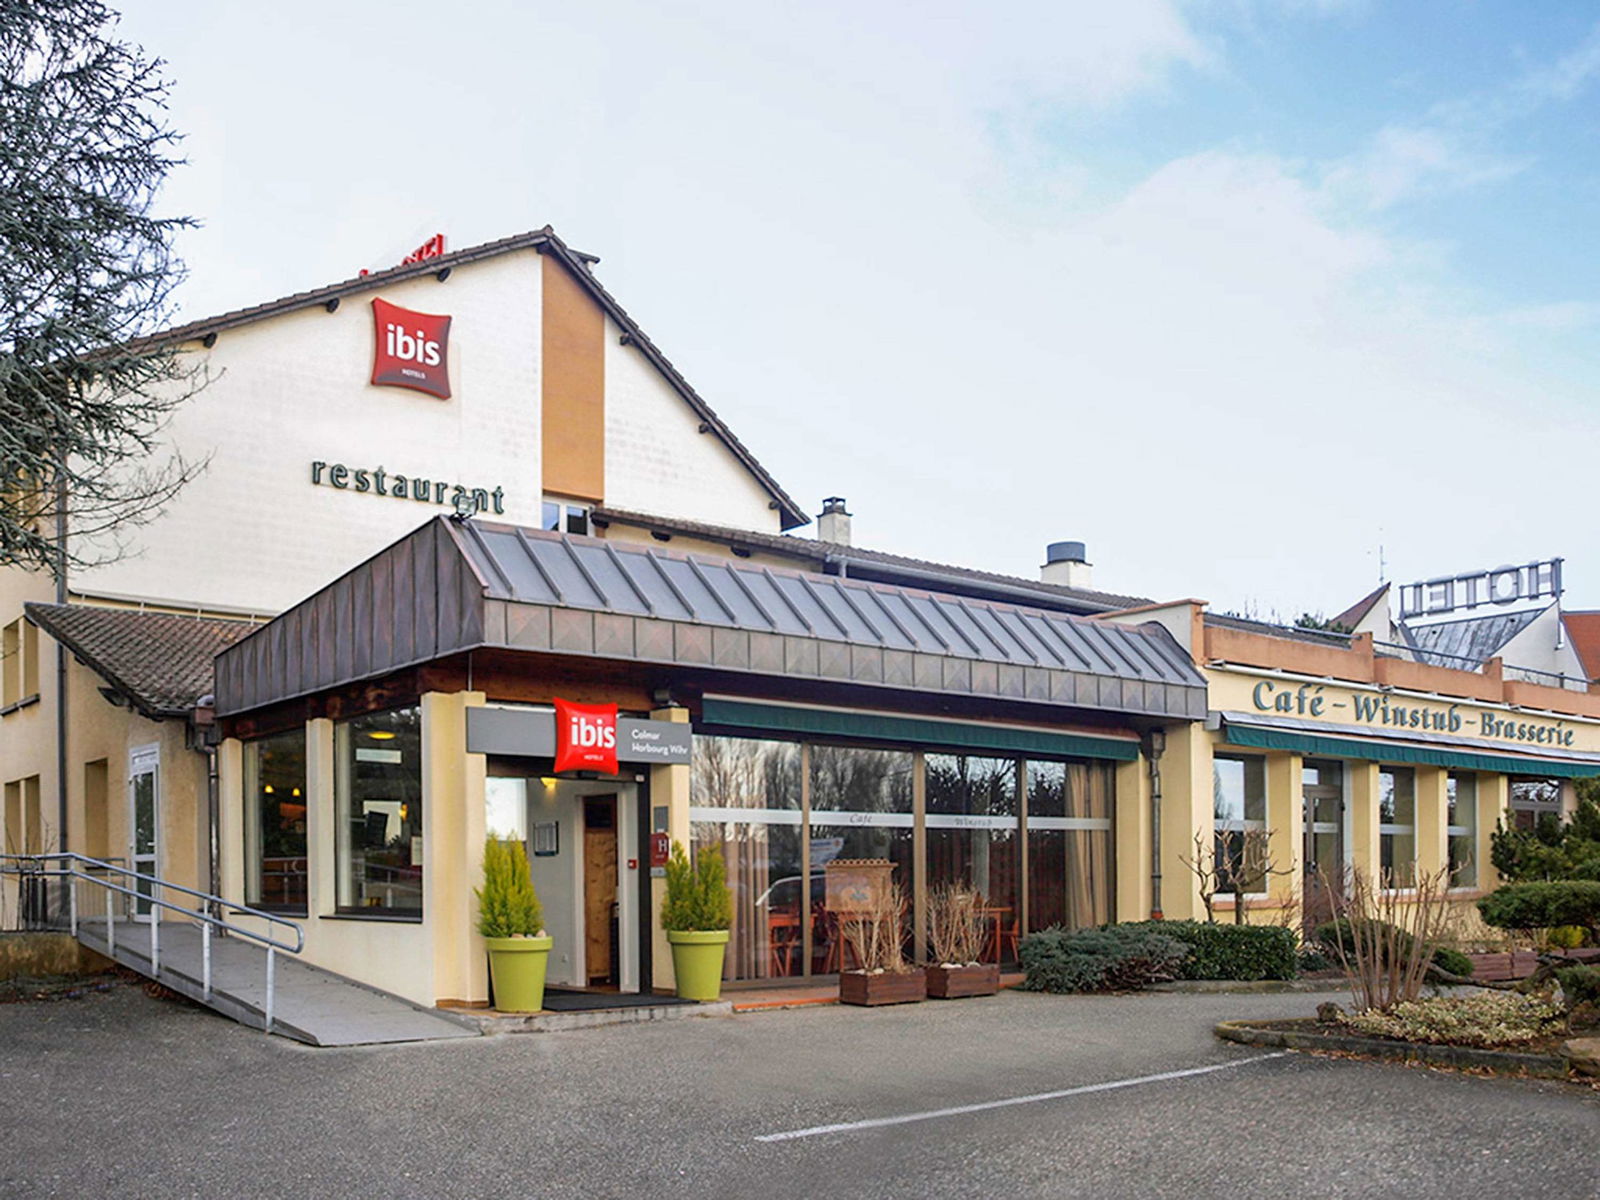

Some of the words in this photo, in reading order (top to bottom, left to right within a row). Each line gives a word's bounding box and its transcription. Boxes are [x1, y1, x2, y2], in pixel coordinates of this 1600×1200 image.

[387, 323, 441, 366] ibis
[311, 460, 505, 515] restaurant
[571, 716, 616, 748] ibis
[631, 728, 661, 740] Colmar
[1253, 680, 1326, 717] Café
[1353, 694, 1461, 733] Winstub
[1480, 711, 1575, 746] Brasserie
